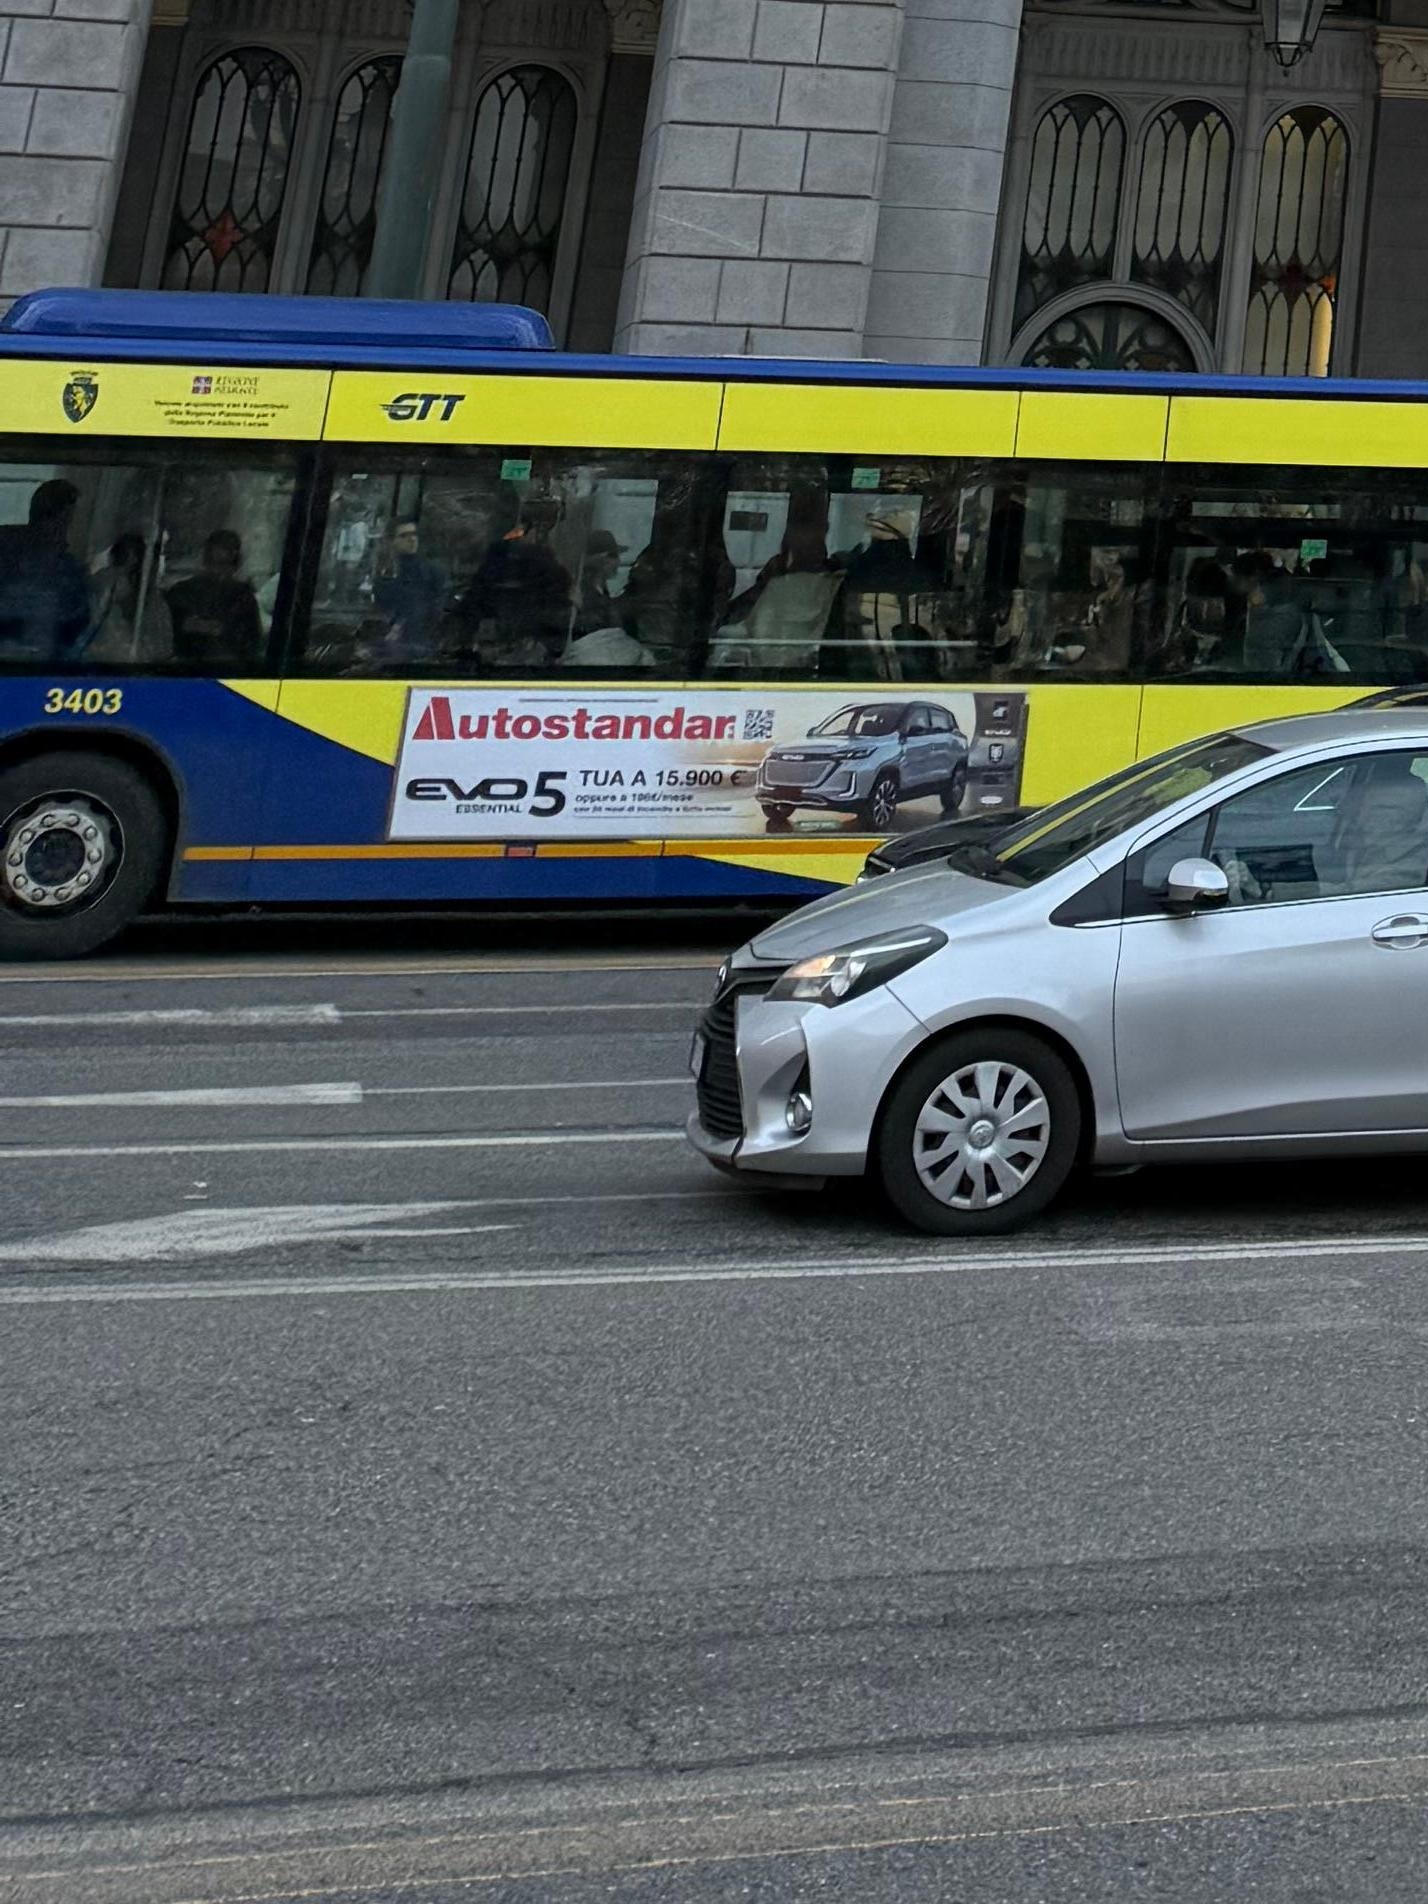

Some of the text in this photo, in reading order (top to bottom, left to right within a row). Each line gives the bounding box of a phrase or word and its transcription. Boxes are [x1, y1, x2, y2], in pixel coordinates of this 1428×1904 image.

[379, 393, 466, 421] GTT
[44, 688, 123, 715] 3403
[412, 696, 737, 740] Autostandar
[579, 769, 748, 787] TUA A 15.900 €
[456, 804, 523, 814] ESSENTIAL
